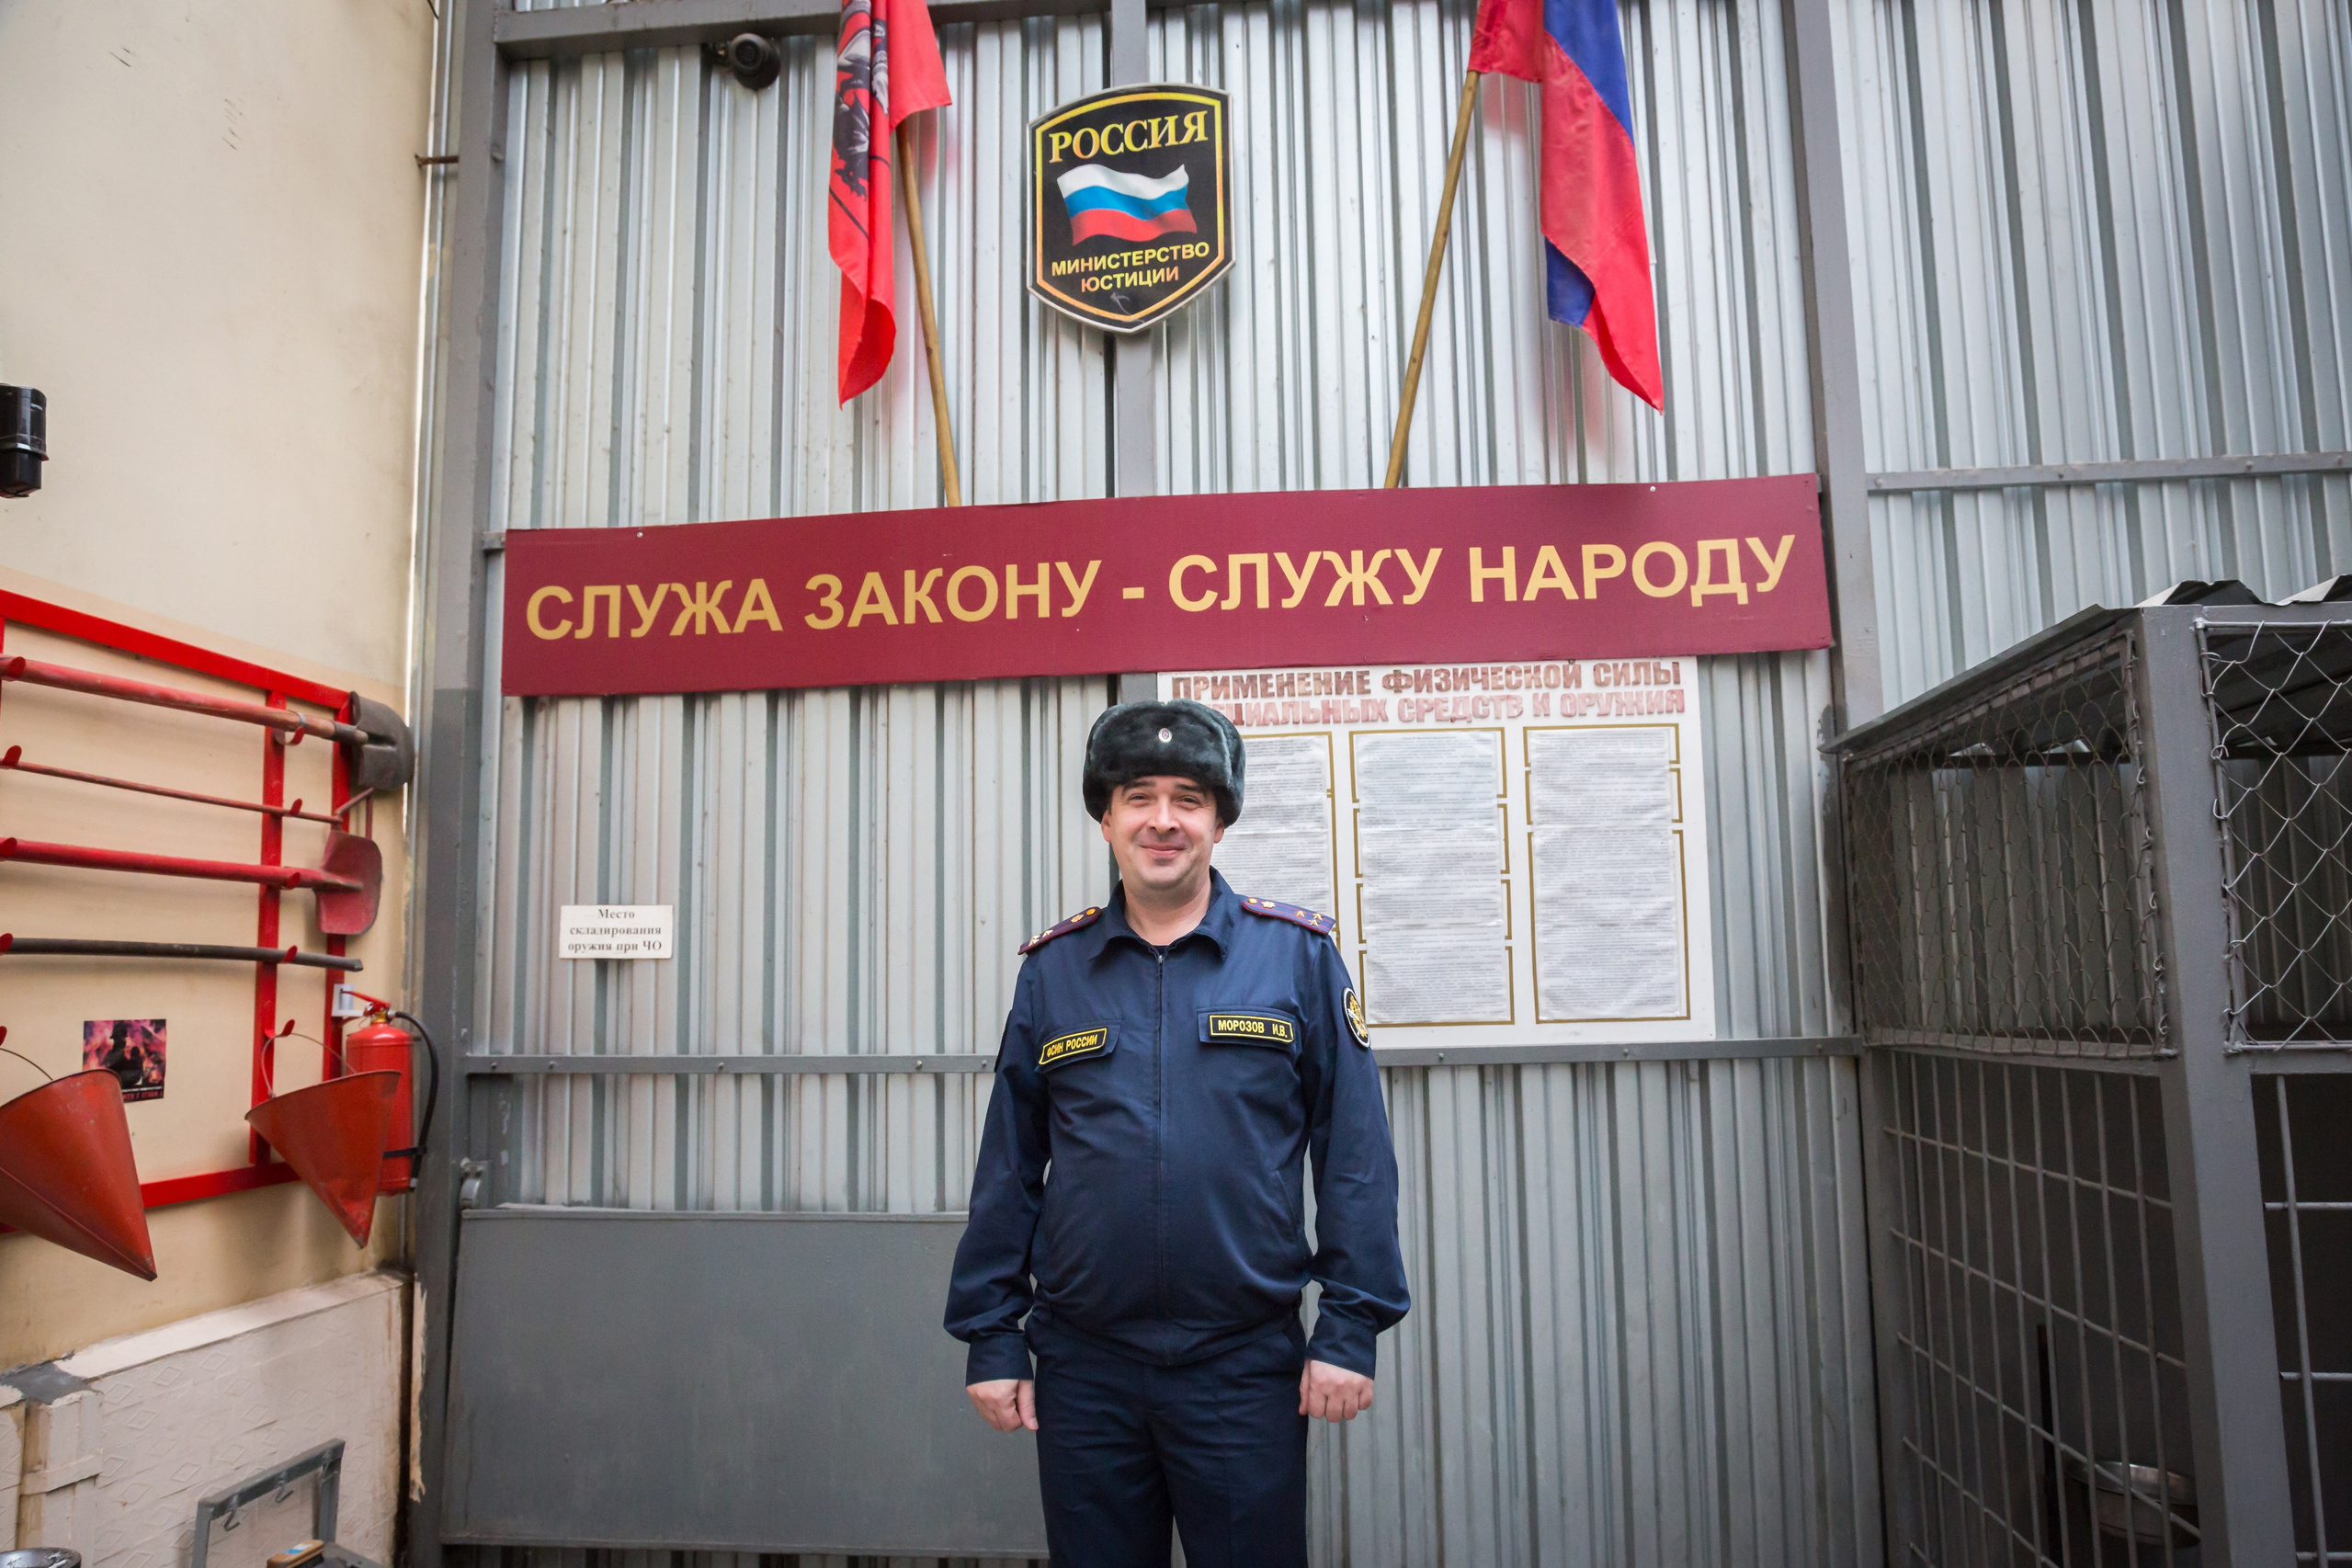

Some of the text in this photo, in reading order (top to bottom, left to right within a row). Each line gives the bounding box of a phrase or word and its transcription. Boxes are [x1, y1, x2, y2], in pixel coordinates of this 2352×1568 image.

[1049, 109, 1209, 164] РОССИЯ
[1051, 242, 1210, 277] МИНИСТЕРСТВО
[1081, 266, 1179, 292] ЮСТИЦИИ
[526, 533, 1796, 641] СЛУЖА ЗАКОНУ - СЛУЖУ НАРОДУ
[1172, 658, 1681, 700] ПРИМЕНЕНИЕ ФИЗИЧЕСКОЙ СИЛЫ
[1205, 688, 1686, 727] ЦИАЛЬНЫХ СРЕДСТВ И ОРУЖИЯ
[597, 909, 635, 919] Место
[569, 926, 662, 937] складирования
[568, 940, 662, 954] оружия при ЧО
[1218, 1019, 1288, 1039] МОРОЗОВ И.В.
[1046, 1034, 1098, 1058] ФСИН РОССИИ
